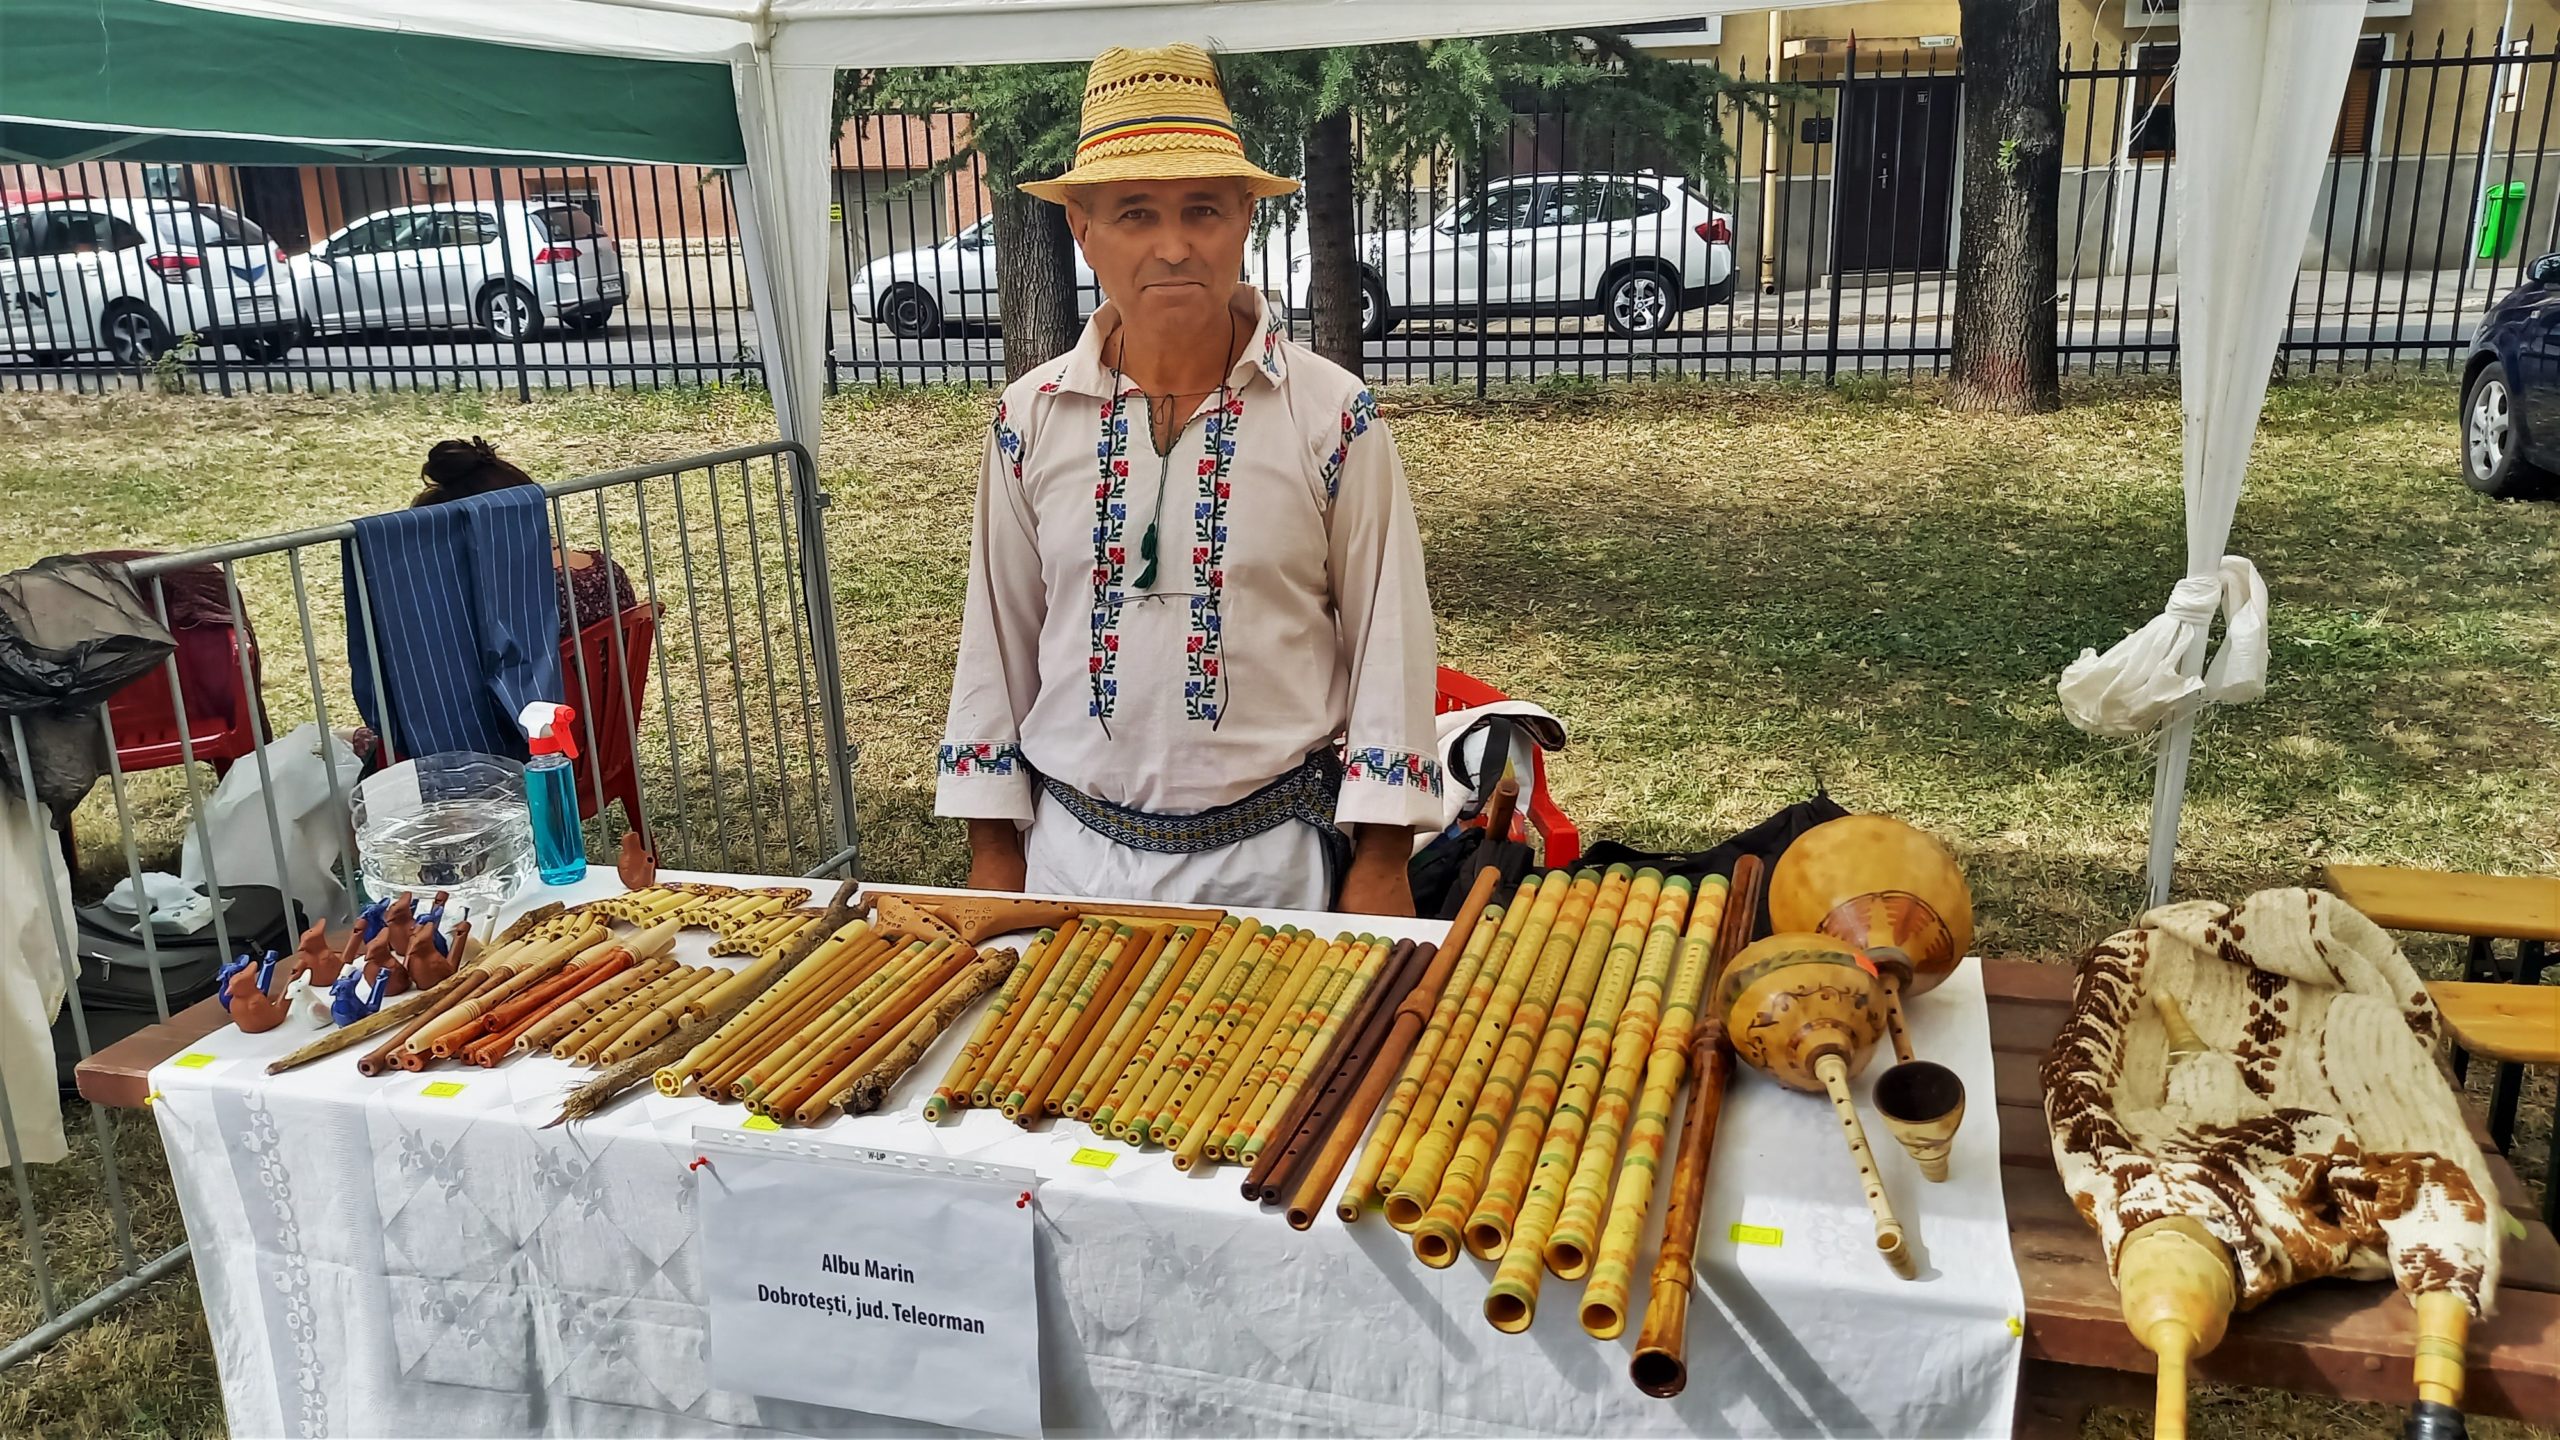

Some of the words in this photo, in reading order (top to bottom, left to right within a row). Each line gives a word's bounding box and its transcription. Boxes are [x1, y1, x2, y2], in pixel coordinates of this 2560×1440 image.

[822, 1254, 860, 1277] Albu
[865, 1259, 915, 1284] Marin
[758, 1284, 852, 1317] Dobrotești,
[856, 1297, 889, 1320] jud.
[892, 1303, 985, 1335] Teleorman
